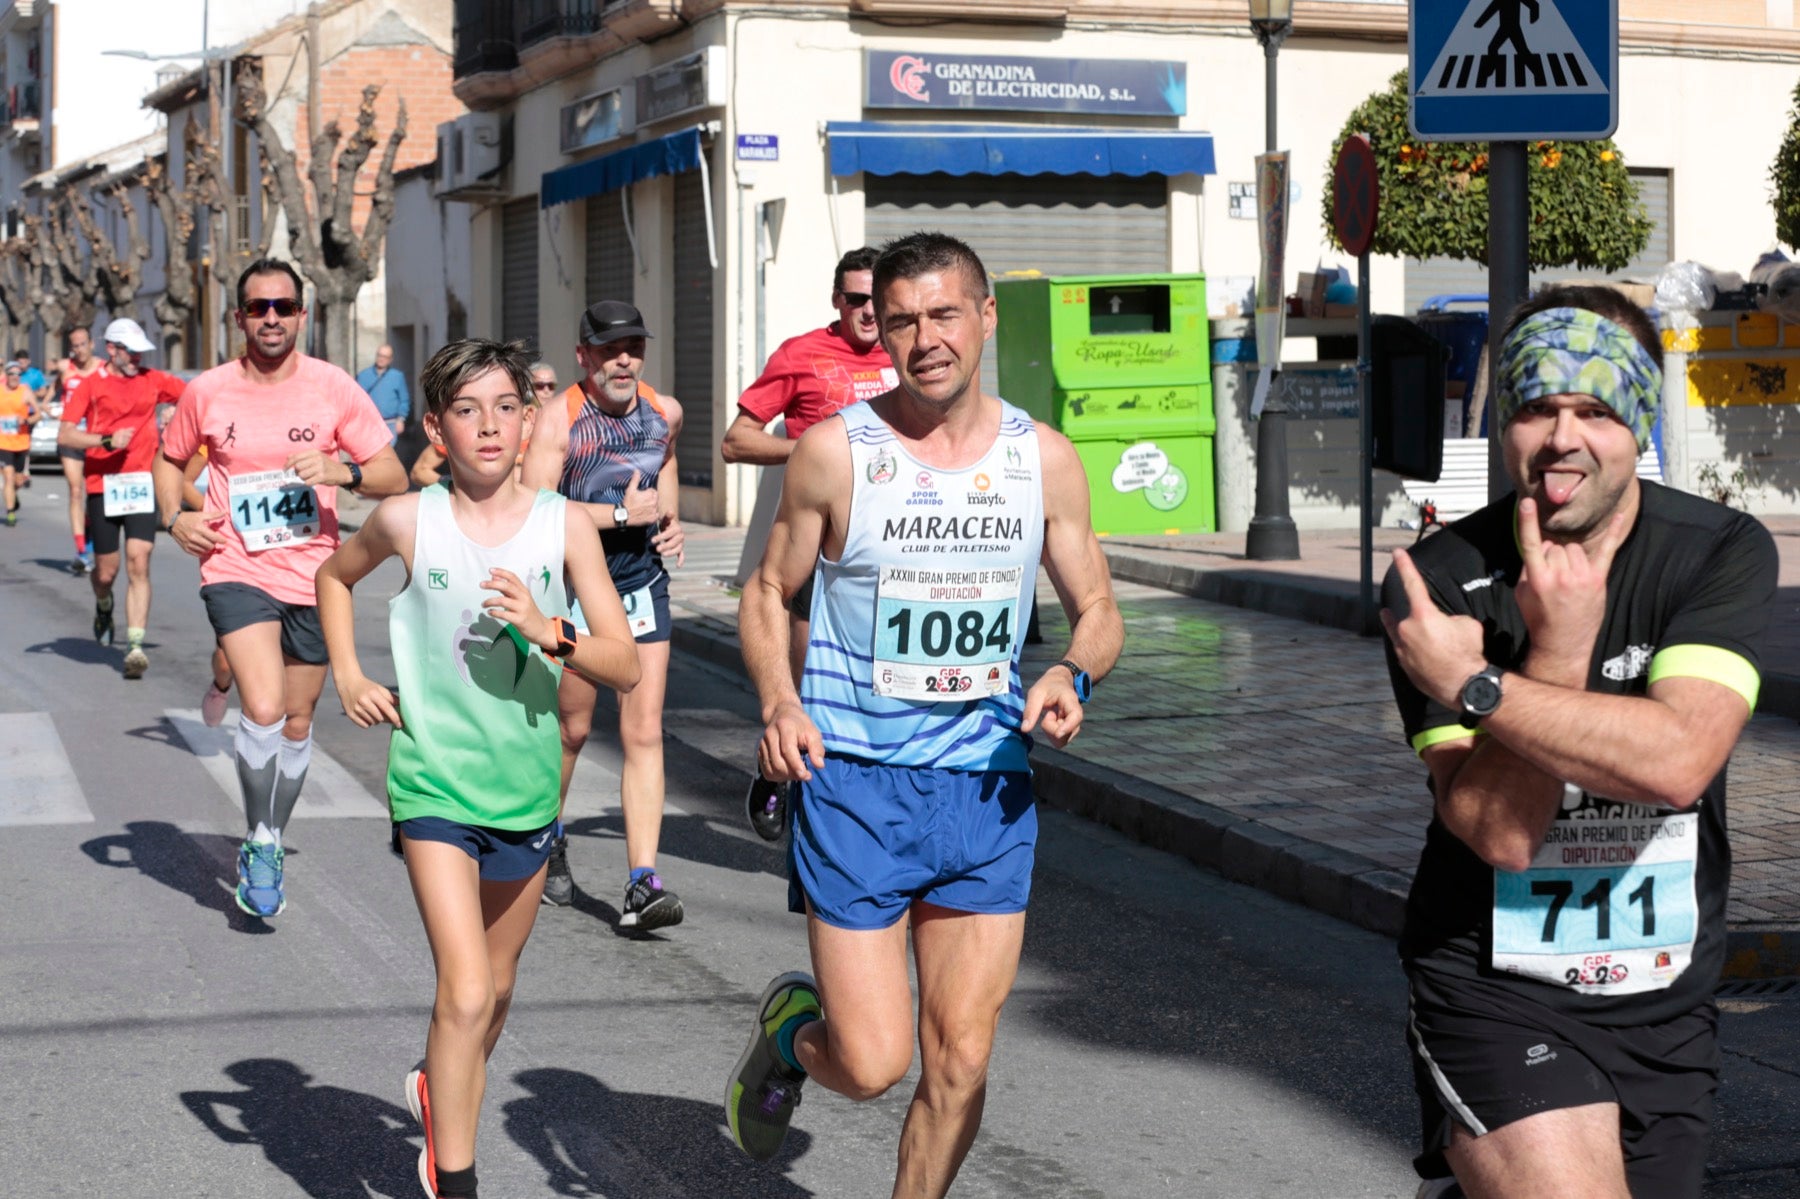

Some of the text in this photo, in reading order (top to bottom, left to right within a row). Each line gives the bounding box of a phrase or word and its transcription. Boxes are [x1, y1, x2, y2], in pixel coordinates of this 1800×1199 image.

[935, 62, 1035, 81] GRANADINA
[949, 80, 1136, 101] DE ELECTRICIDAD, S.L.
[744, 136, 769, 145] PLAZA
[854, 381, 882, 391] MEDIA
[1320, 384, 1354, 397] papel
[288, 427, 315, 442] GO
[111, 486, 148, 501] 1154
[967, 493, 1006, 507] mayfo
[238, 490, 314, 526] 1144
[882, 516, 1023, 541] MARACENA
[901, 544, 1011, 553] CLUB DE ATLETISMO
[890, 568, 1016, 585] XXXIII GRAN PREMIO DE FONDO
[930, 586, 982, 600] DIPUTACIÓN
[888, 607, 1011, 658] 1084
[1583, 826, 1629, 843] PREMIO
[1632, 825, 1647, 842] DE
[1649, 821, 1686, 841] FONDO
[1562, 843, 1637, 864] DIPUTACIÓN
[1530, 875, 1656, 943] 711
